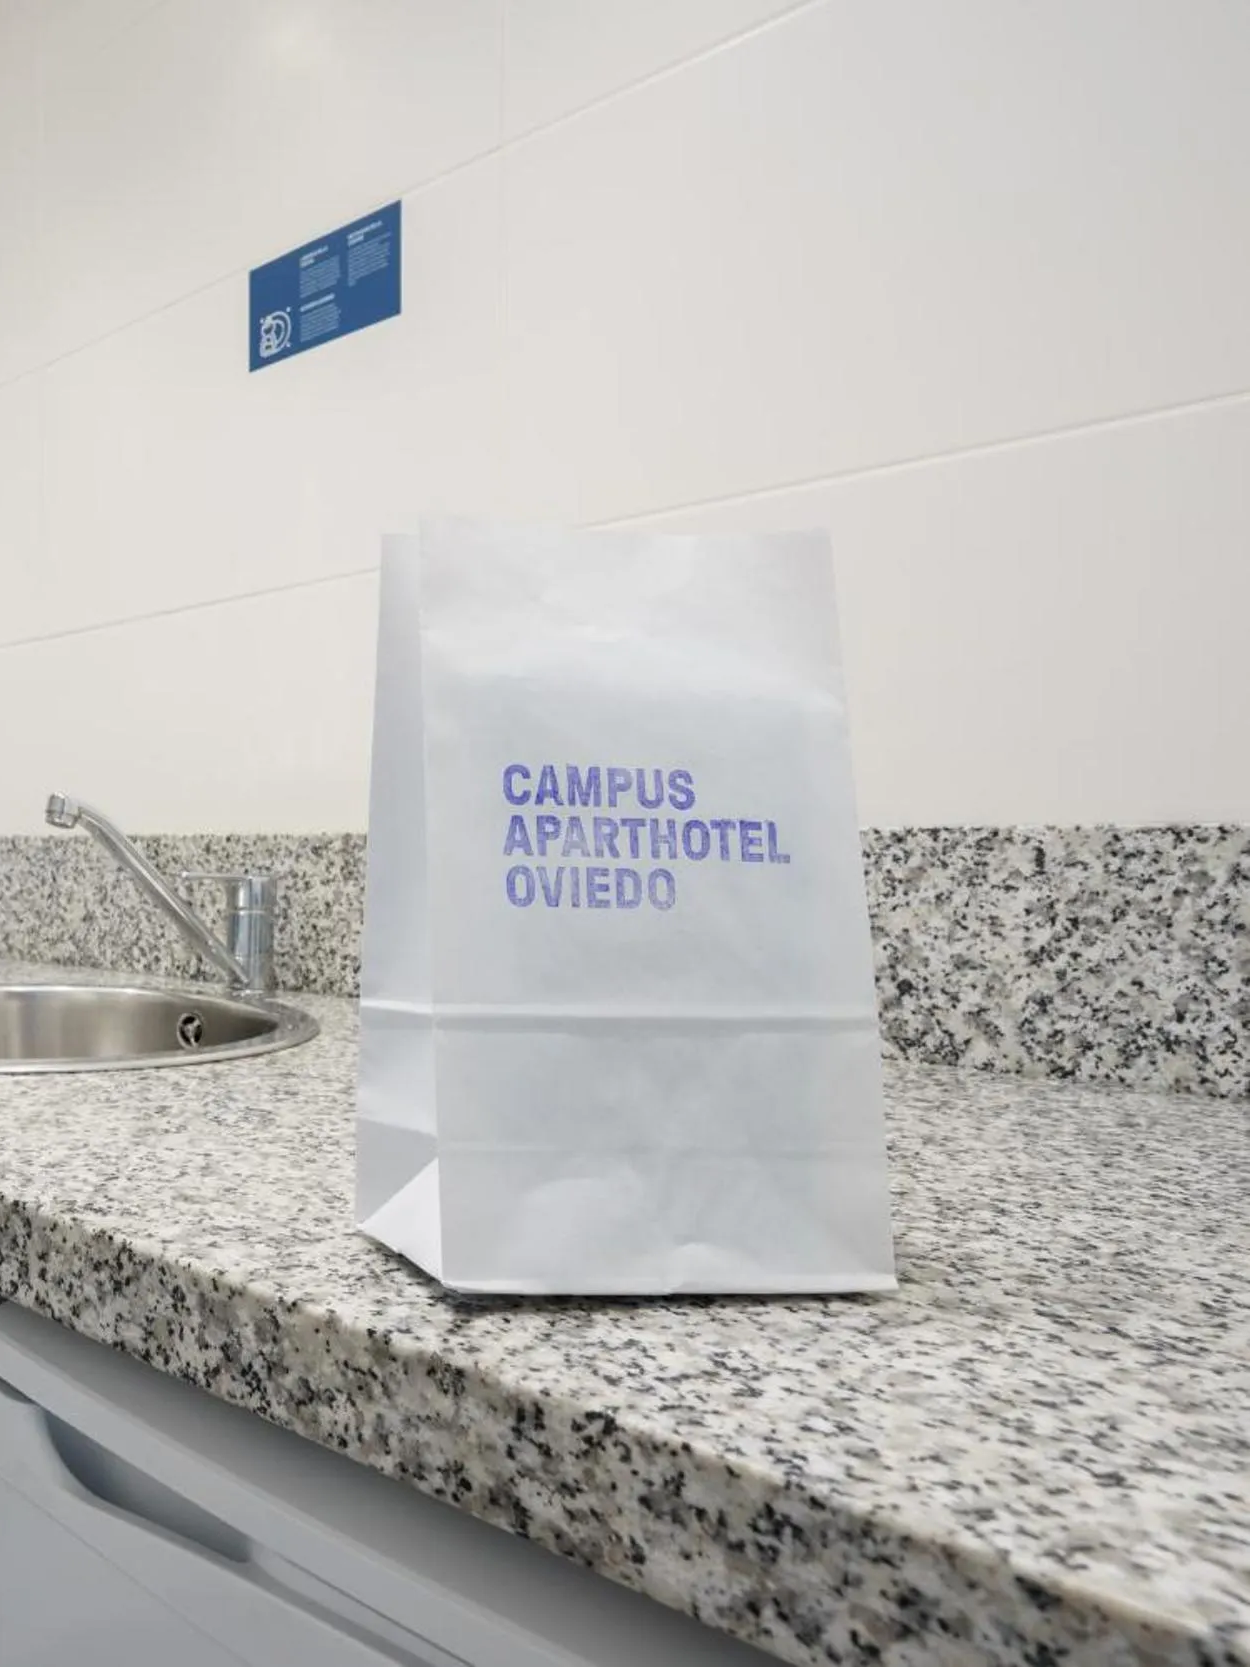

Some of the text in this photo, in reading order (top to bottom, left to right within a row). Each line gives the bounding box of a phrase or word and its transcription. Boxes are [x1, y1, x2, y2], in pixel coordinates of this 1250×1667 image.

[503, 764, 696, 810] CAMPUS
[503, 814, 790, 863] APARTHOTEL
[506, 865, 676, 911] OVIEDO
